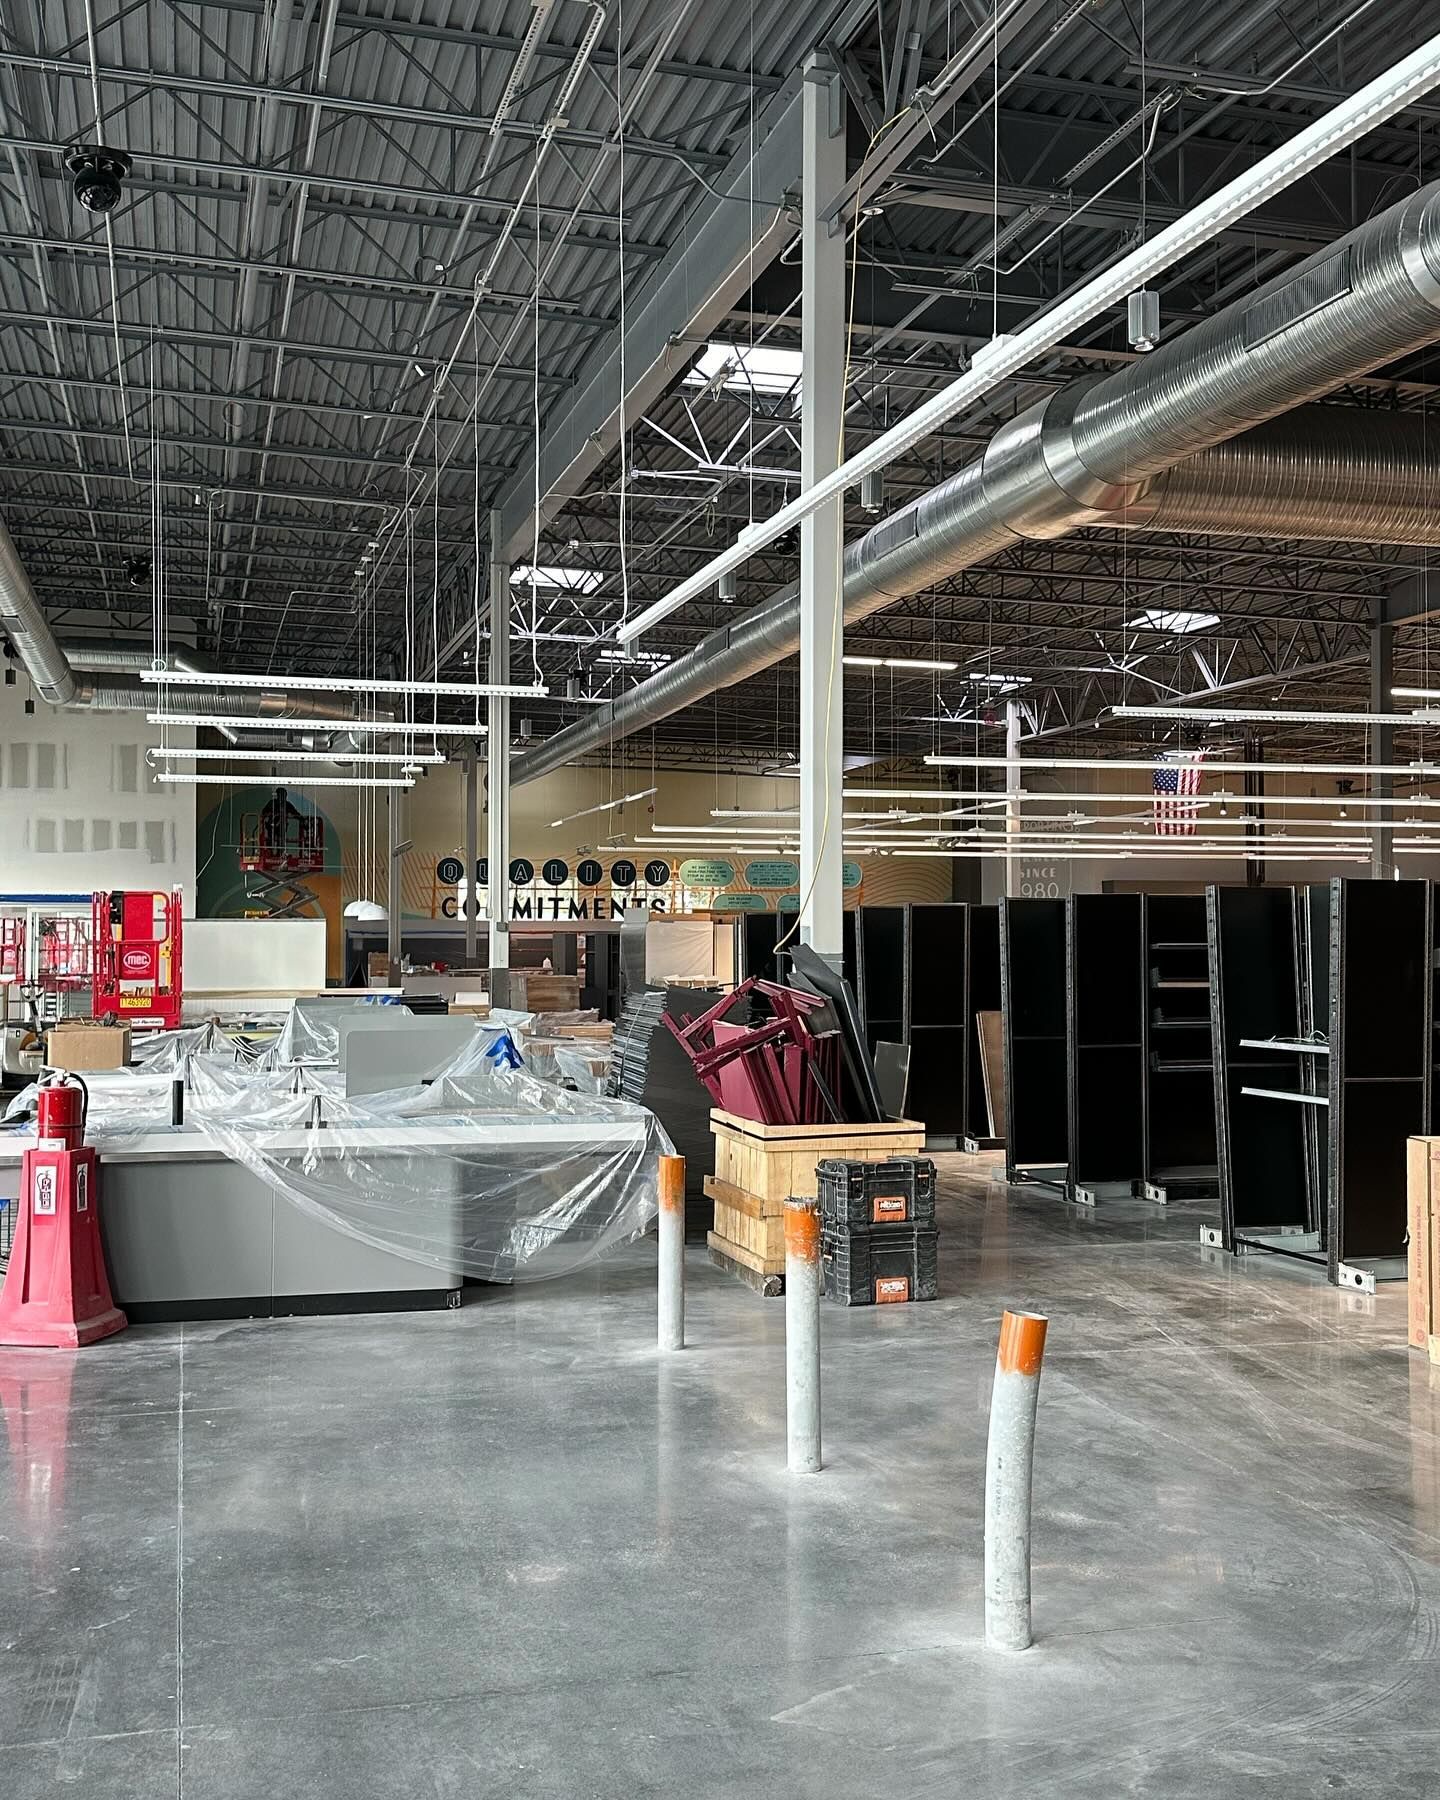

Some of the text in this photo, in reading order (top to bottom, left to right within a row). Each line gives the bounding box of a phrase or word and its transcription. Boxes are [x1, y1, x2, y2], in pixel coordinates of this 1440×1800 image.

[442, 862, 664, 883] QUALITY
[1021, 882, 1059, 898] 980
[441, 896, 666, 920] COMITMENTS
